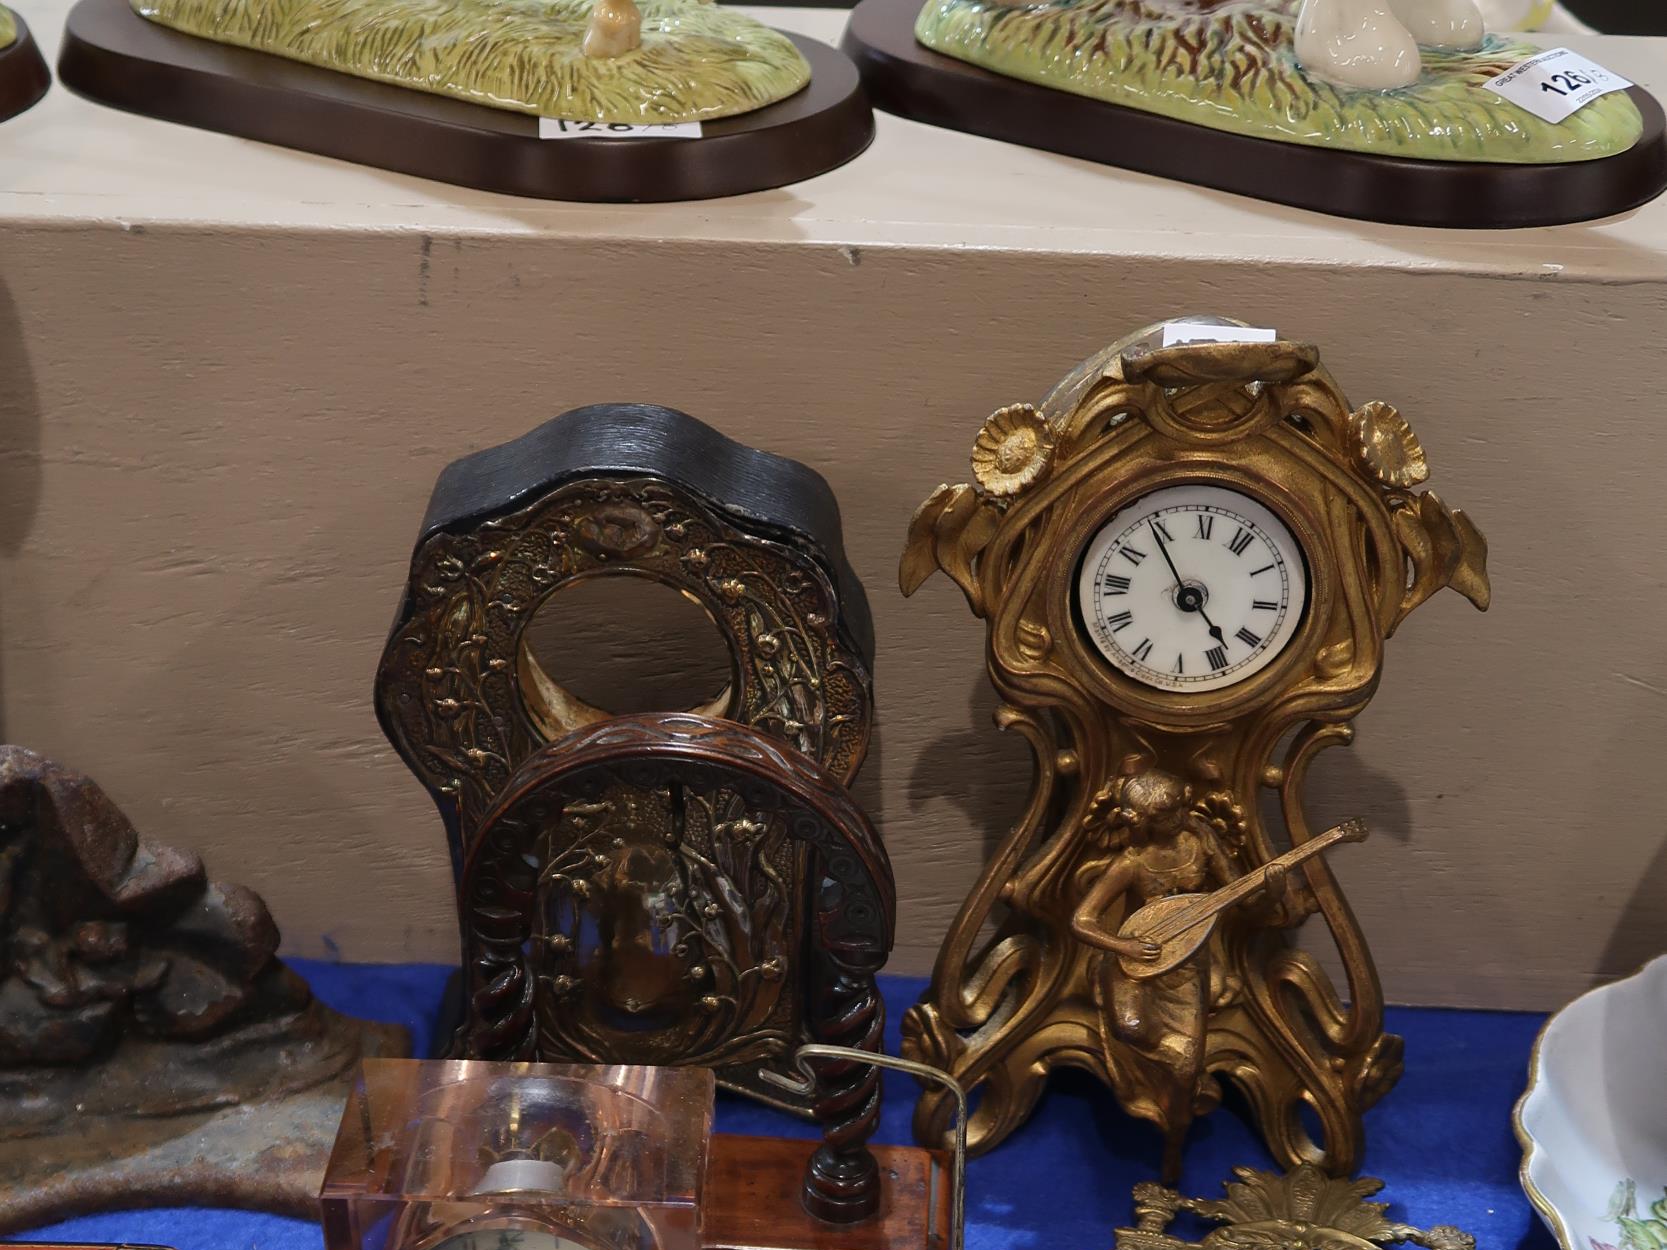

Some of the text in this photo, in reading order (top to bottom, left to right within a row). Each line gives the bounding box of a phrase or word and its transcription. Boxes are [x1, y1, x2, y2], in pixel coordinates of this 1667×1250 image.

[1193, 514, 1214, 541] XI
[1118, 540, 1147, 567] IX
[1222, 526, 1255, 557] XII
[1250, 564, 1275, 577] I
[1103, 574, 1132, 597] VIII
[1252, 599, 1278, 611] II
[1107, 609, 1134, 633] VII
[1235, 626, 1262, 648] III
[1132, 638, 1154, 662] VI
[1205, 645, 1230, 671] IIII
[1170, 652, 1184, 674] V
